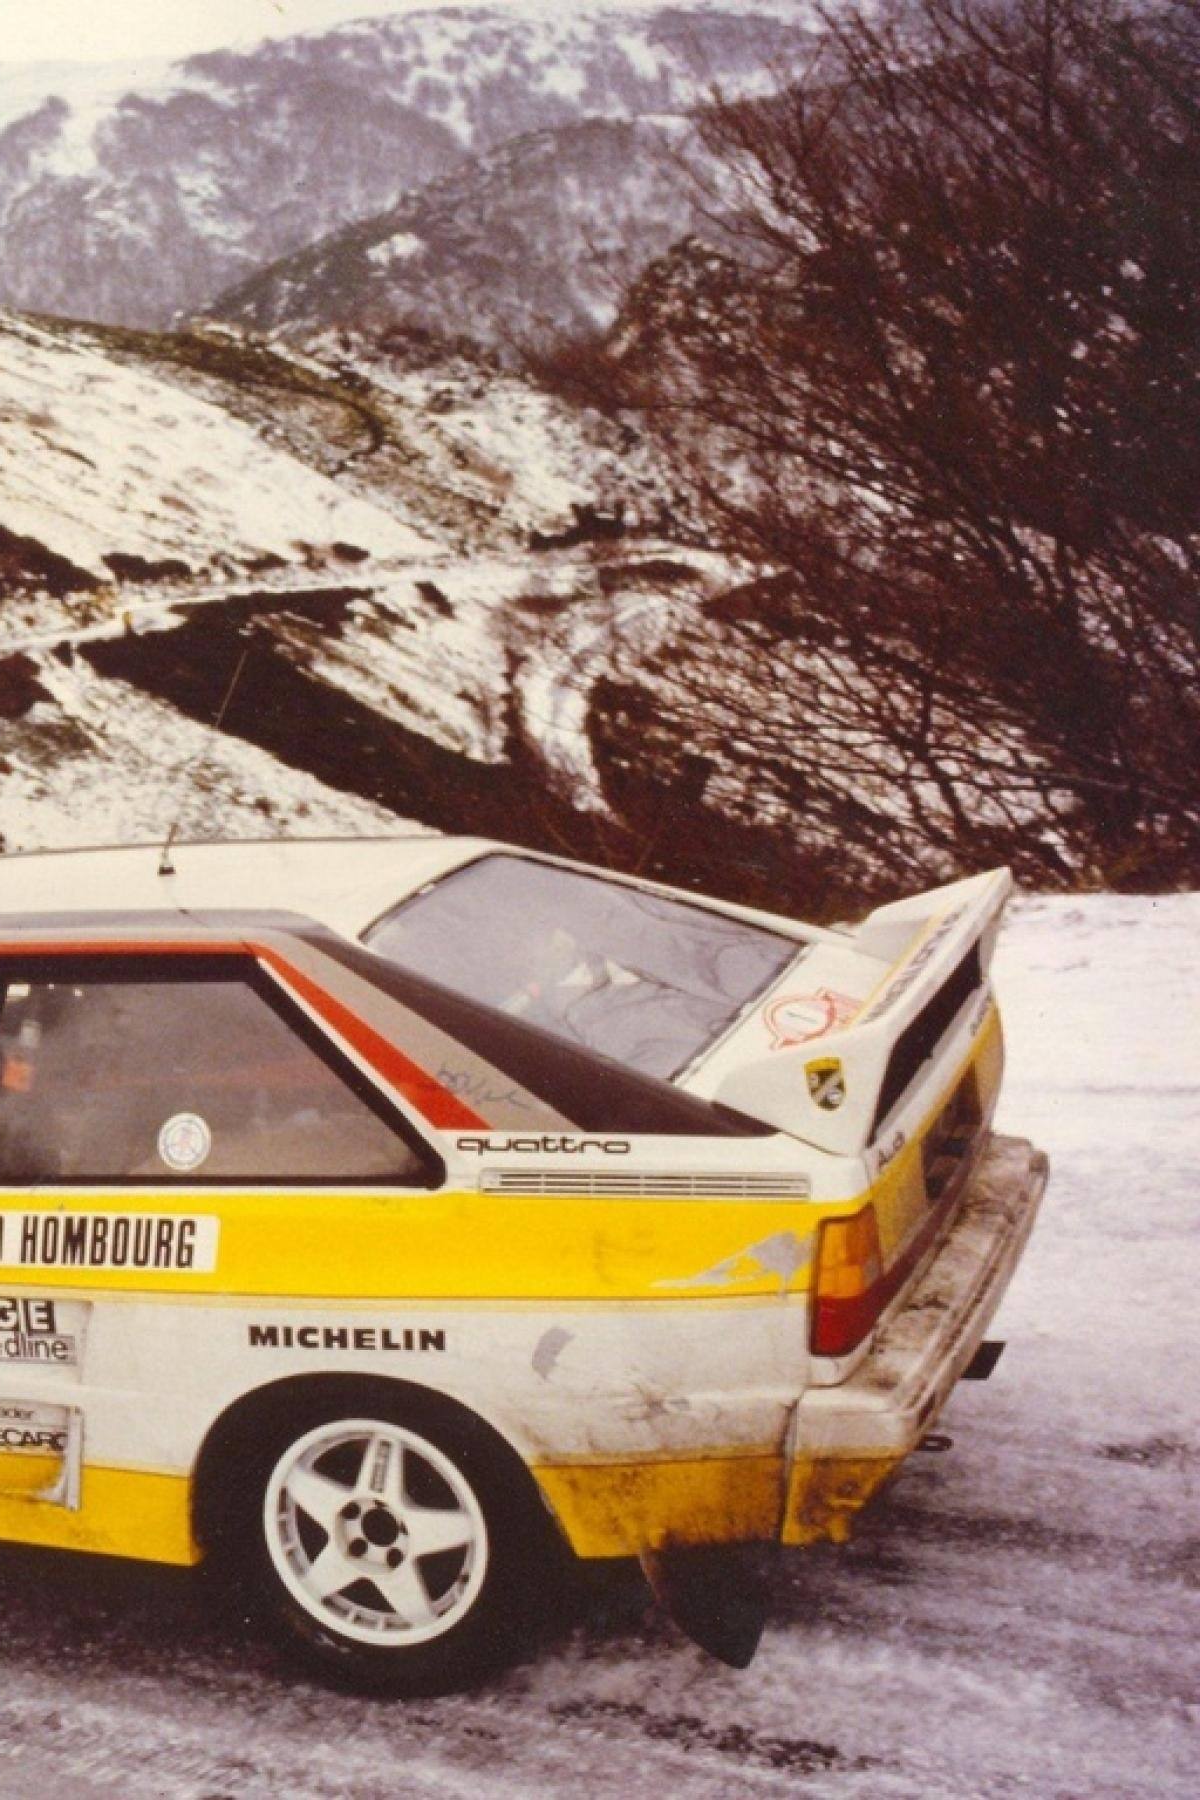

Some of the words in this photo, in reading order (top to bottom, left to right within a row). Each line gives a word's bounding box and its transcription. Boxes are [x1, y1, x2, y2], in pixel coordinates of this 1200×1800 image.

[456, 1136, 631, 1156] quattro
[20, 1215, 196, 1269] HOMBOURG
[249, 1325, 446, 1351] MICHELIN
